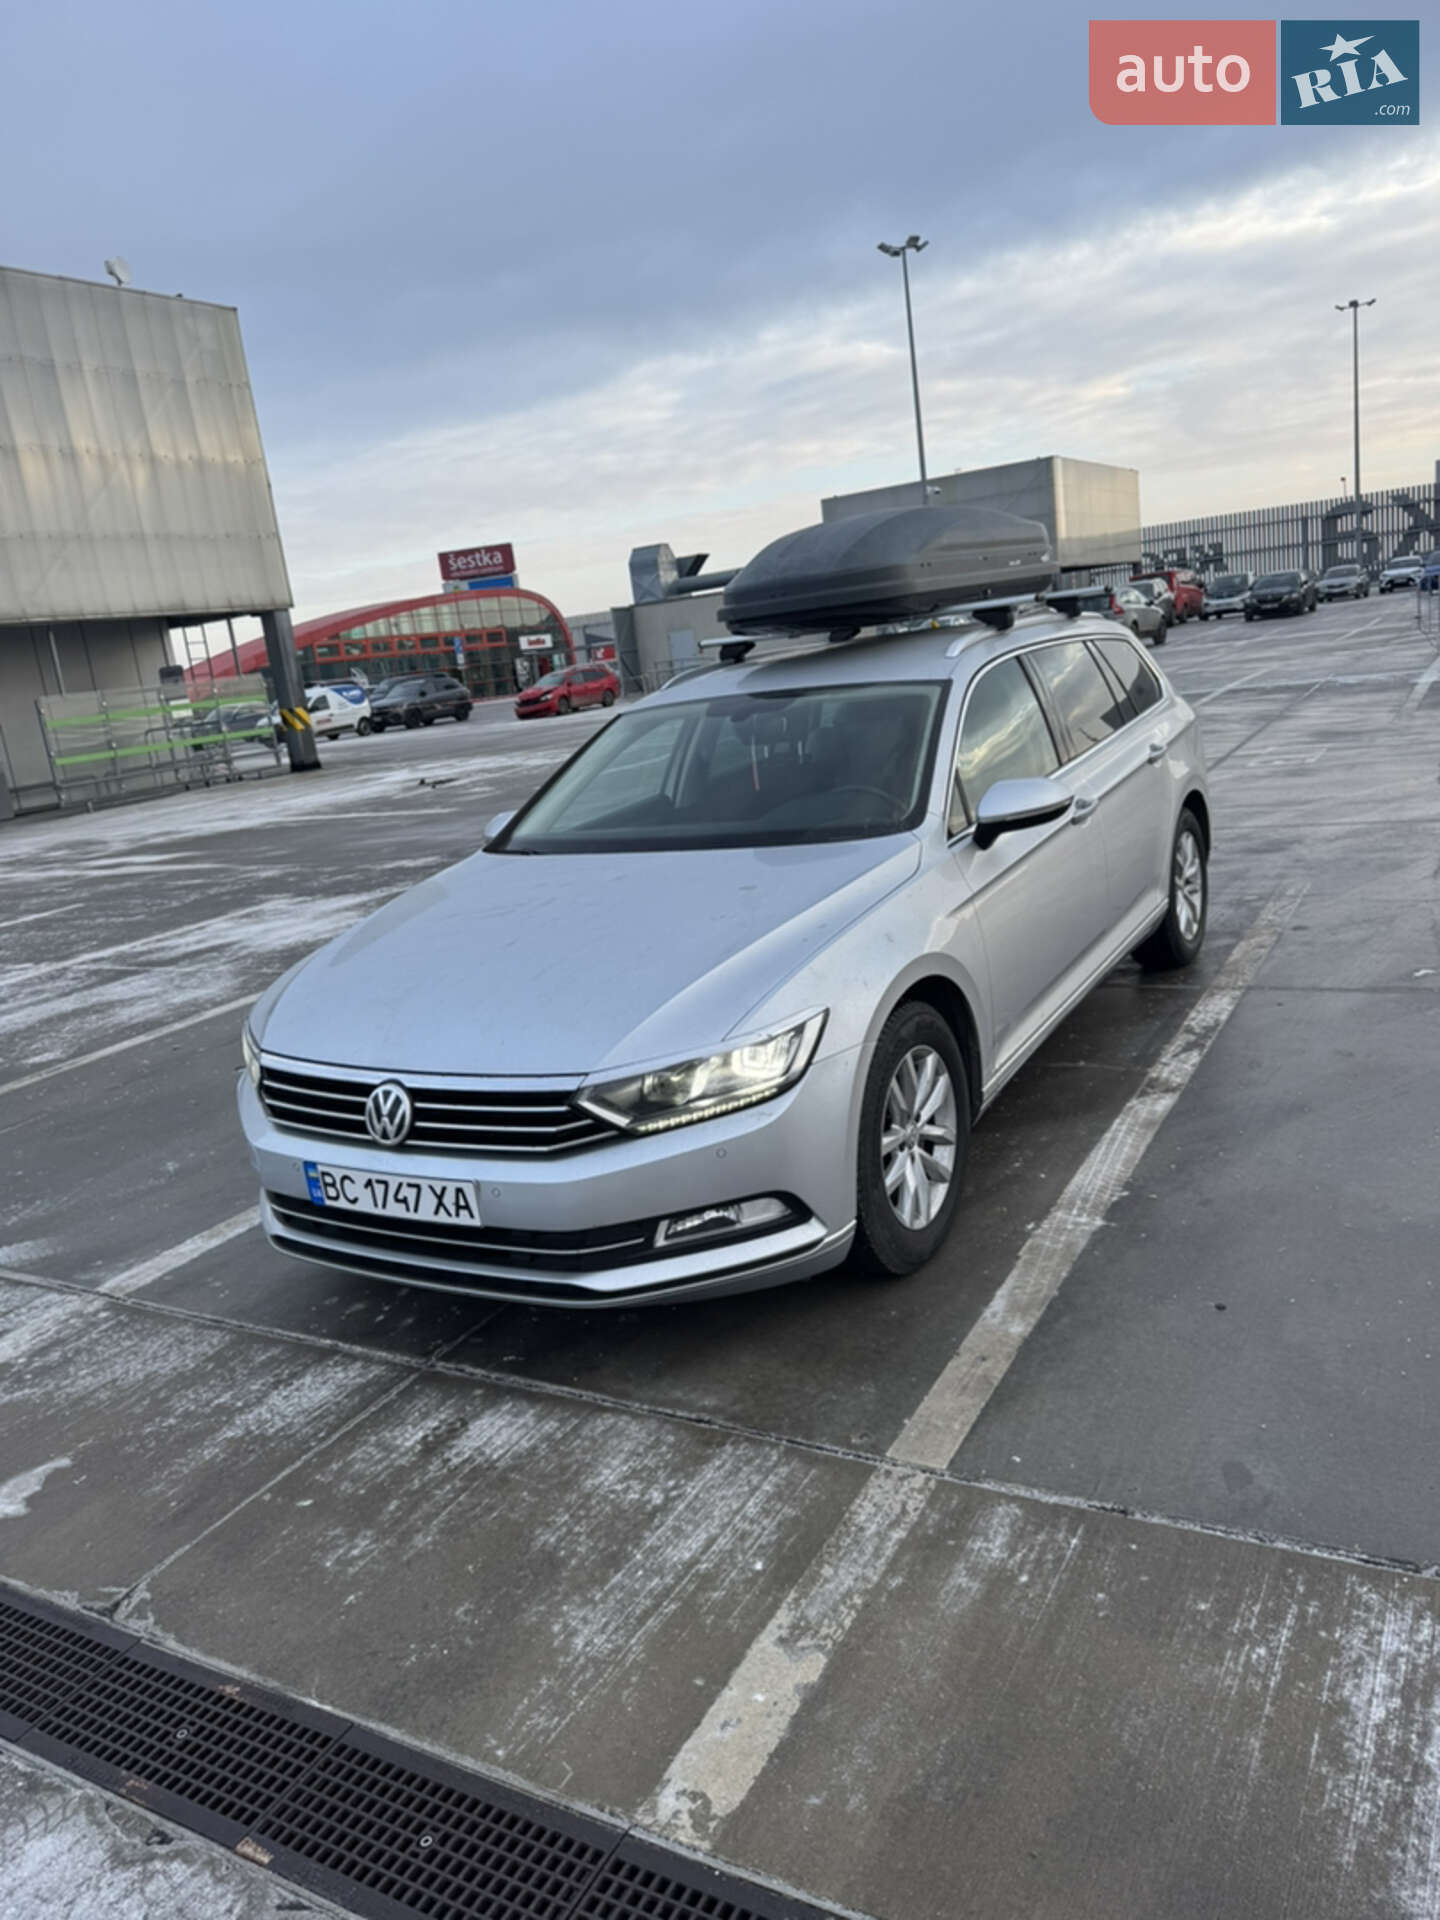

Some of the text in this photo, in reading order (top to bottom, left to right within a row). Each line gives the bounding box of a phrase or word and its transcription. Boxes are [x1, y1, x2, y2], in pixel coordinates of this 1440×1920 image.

[320, 1170, 475, 1219] BC 1747 XA
